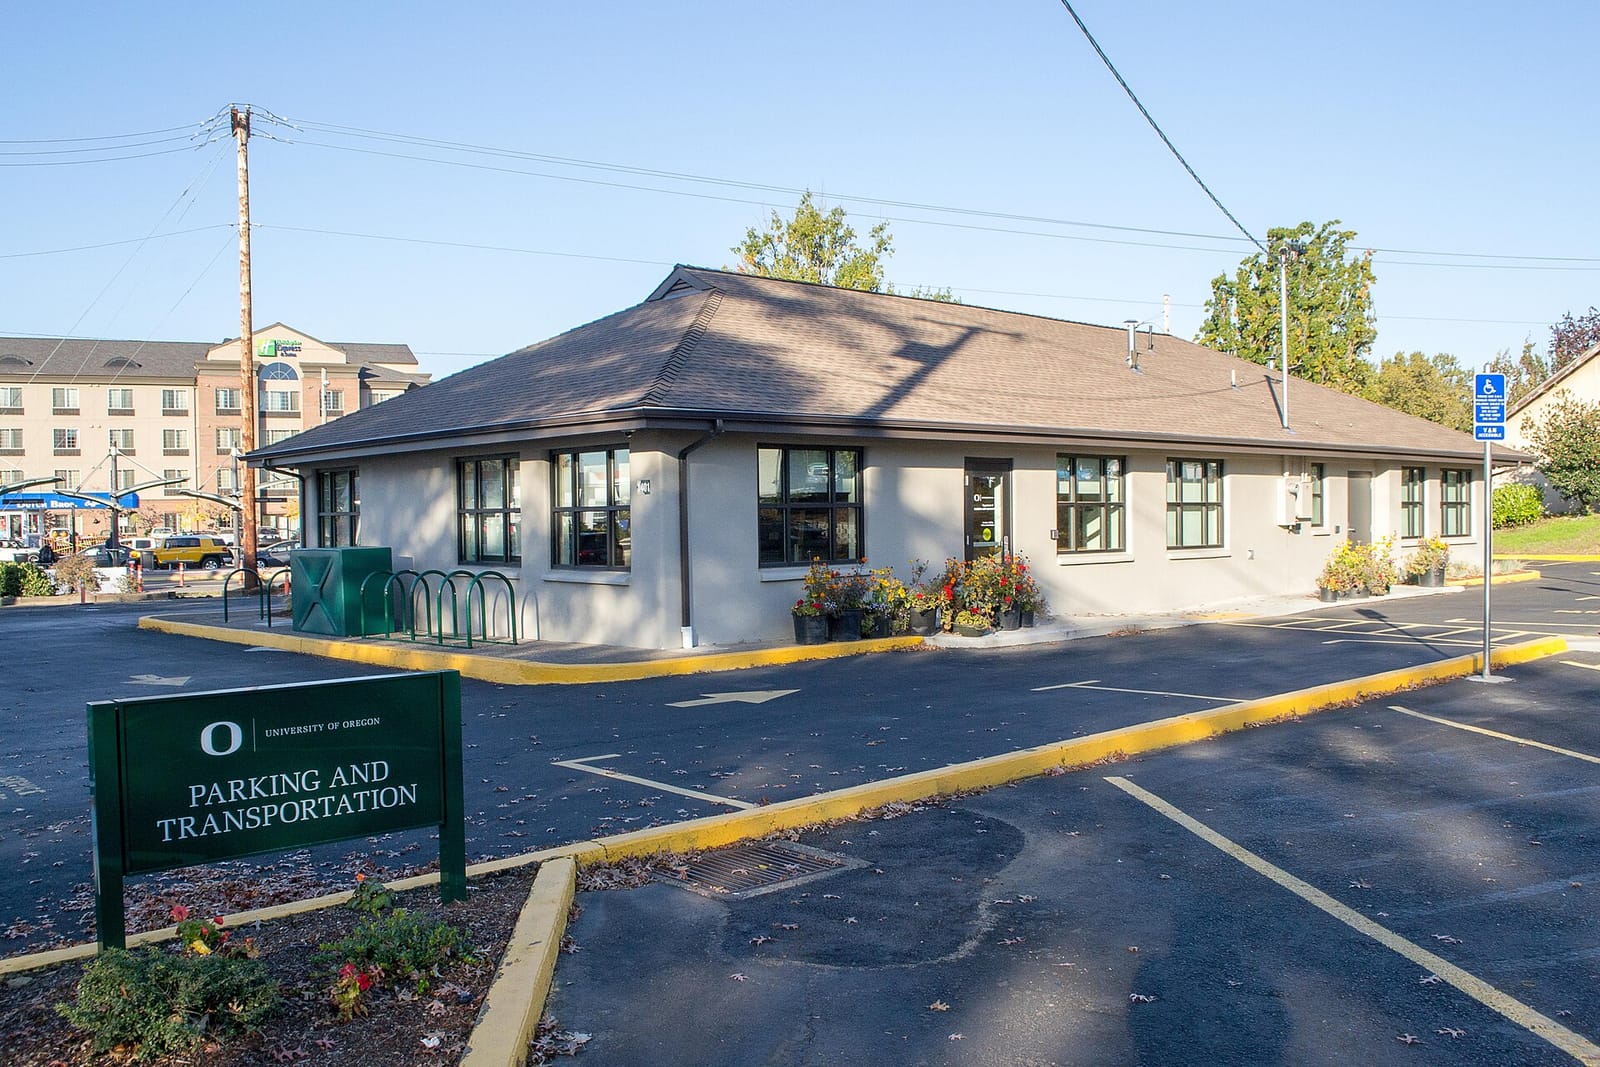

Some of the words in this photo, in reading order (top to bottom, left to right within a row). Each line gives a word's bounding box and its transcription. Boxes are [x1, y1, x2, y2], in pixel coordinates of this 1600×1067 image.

[265, 723, 324, 737] UNIVERSITY
[327, 722, 340, 730] OF
[342, 717, 380, 728] OREGON
[188, 769, 321, 808] PARKING
[329, 760, 389, 789] AND
[157, 783, 418, 842] TRANSPORTATION
